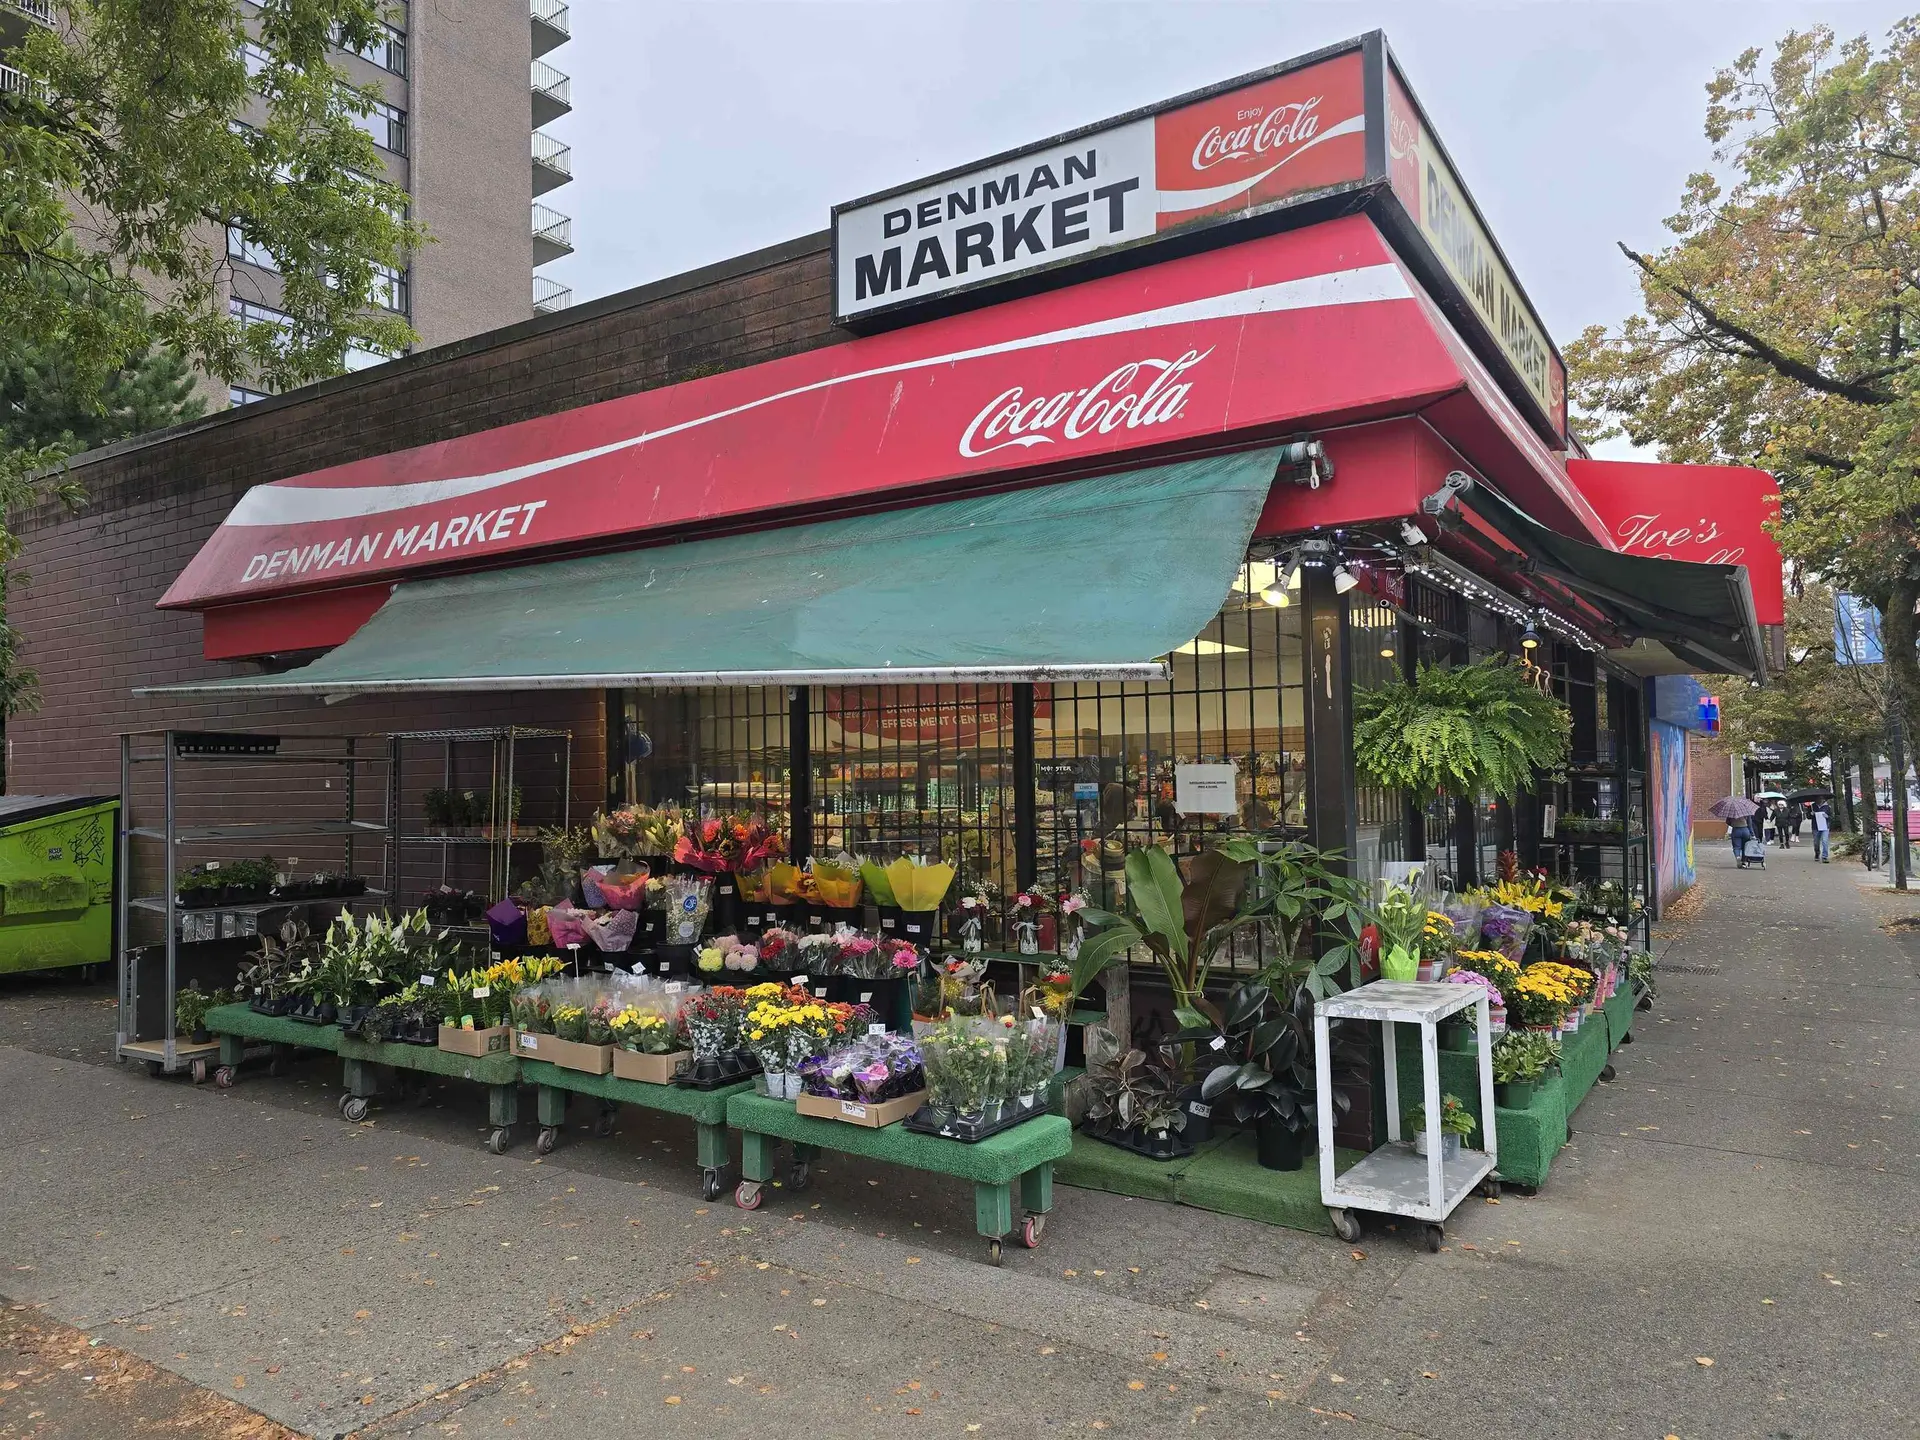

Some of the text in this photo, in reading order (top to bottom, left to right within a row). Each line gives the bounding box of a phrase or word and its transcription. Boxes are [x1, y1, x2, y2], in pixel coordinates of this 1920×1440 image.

[1192, 95, 1324, 170] Coca-Cola
[1237, 105, 1264, 121] Enjoy
[884, 149, 1097, 239] DENMAN
[855, 177, 1140, 301] MARKET
[1427, 160, 1546, 400] DENMAN MARKET
[958, 345, 1217, 458] Coca-Cola
[240, 499, 547, 584] DENMAN MARKET
[1617, 513, 1724, 553] Joe's
